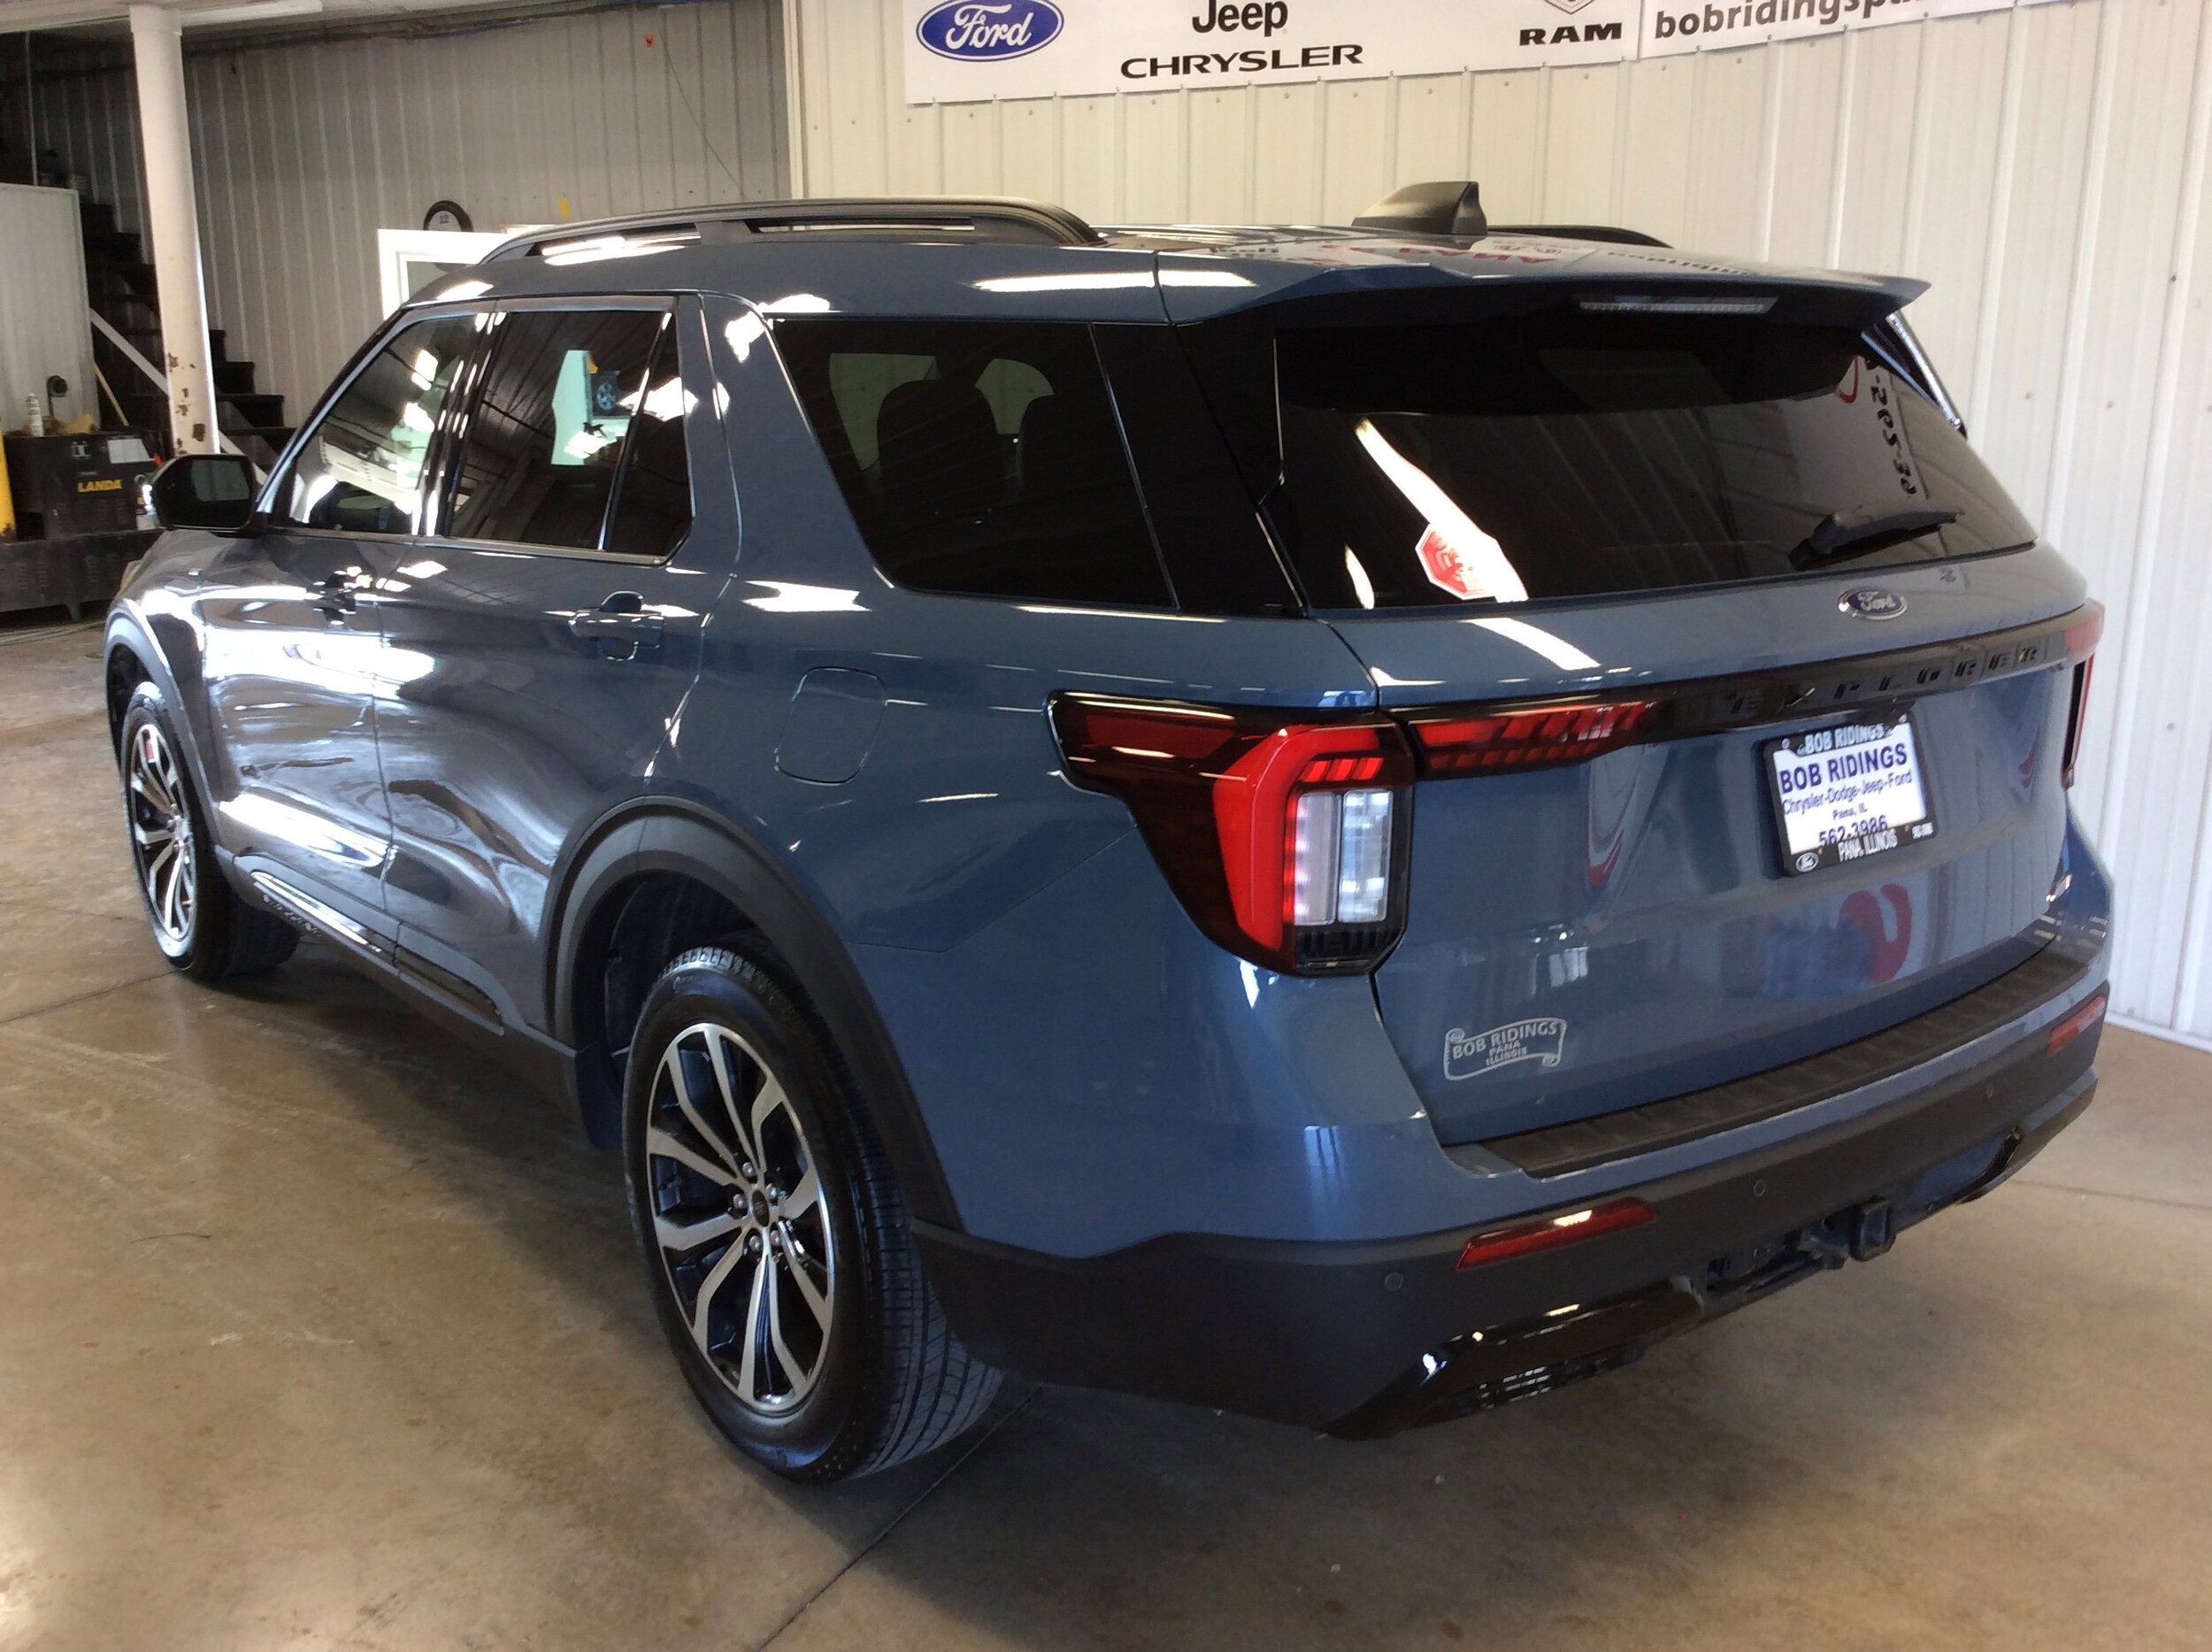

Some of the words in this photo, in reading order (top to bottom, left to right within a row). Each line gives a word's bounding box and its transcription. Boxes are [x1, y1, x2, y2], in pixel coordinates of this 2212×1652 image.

[945, 4, 1034, 50] Ford
[1192, 0, 1288, 37] Jeep
[1519, 22, 1623, 46] RAM
[1655, 0, 1909, 38] bobridingsp
[1120, 44, 1363, 79] CHRYSLER
[1857, 590, 1896, 611] Ford
[1731, 645, 2039, 715] EXPLORER
[1805, 732, 1832, 754] BOB
[1835, 725, 1884, 748] RIDINGS
[1780, 763, 1822, 795] BOB
[1828, 744, 1907, 781] RIDINGS
[1453, 1040, 1486, 1059] BOB
[1491, 1023, 1557, 1047] RIDINGS
[1489, 1041, 1521, 1057] PANA
